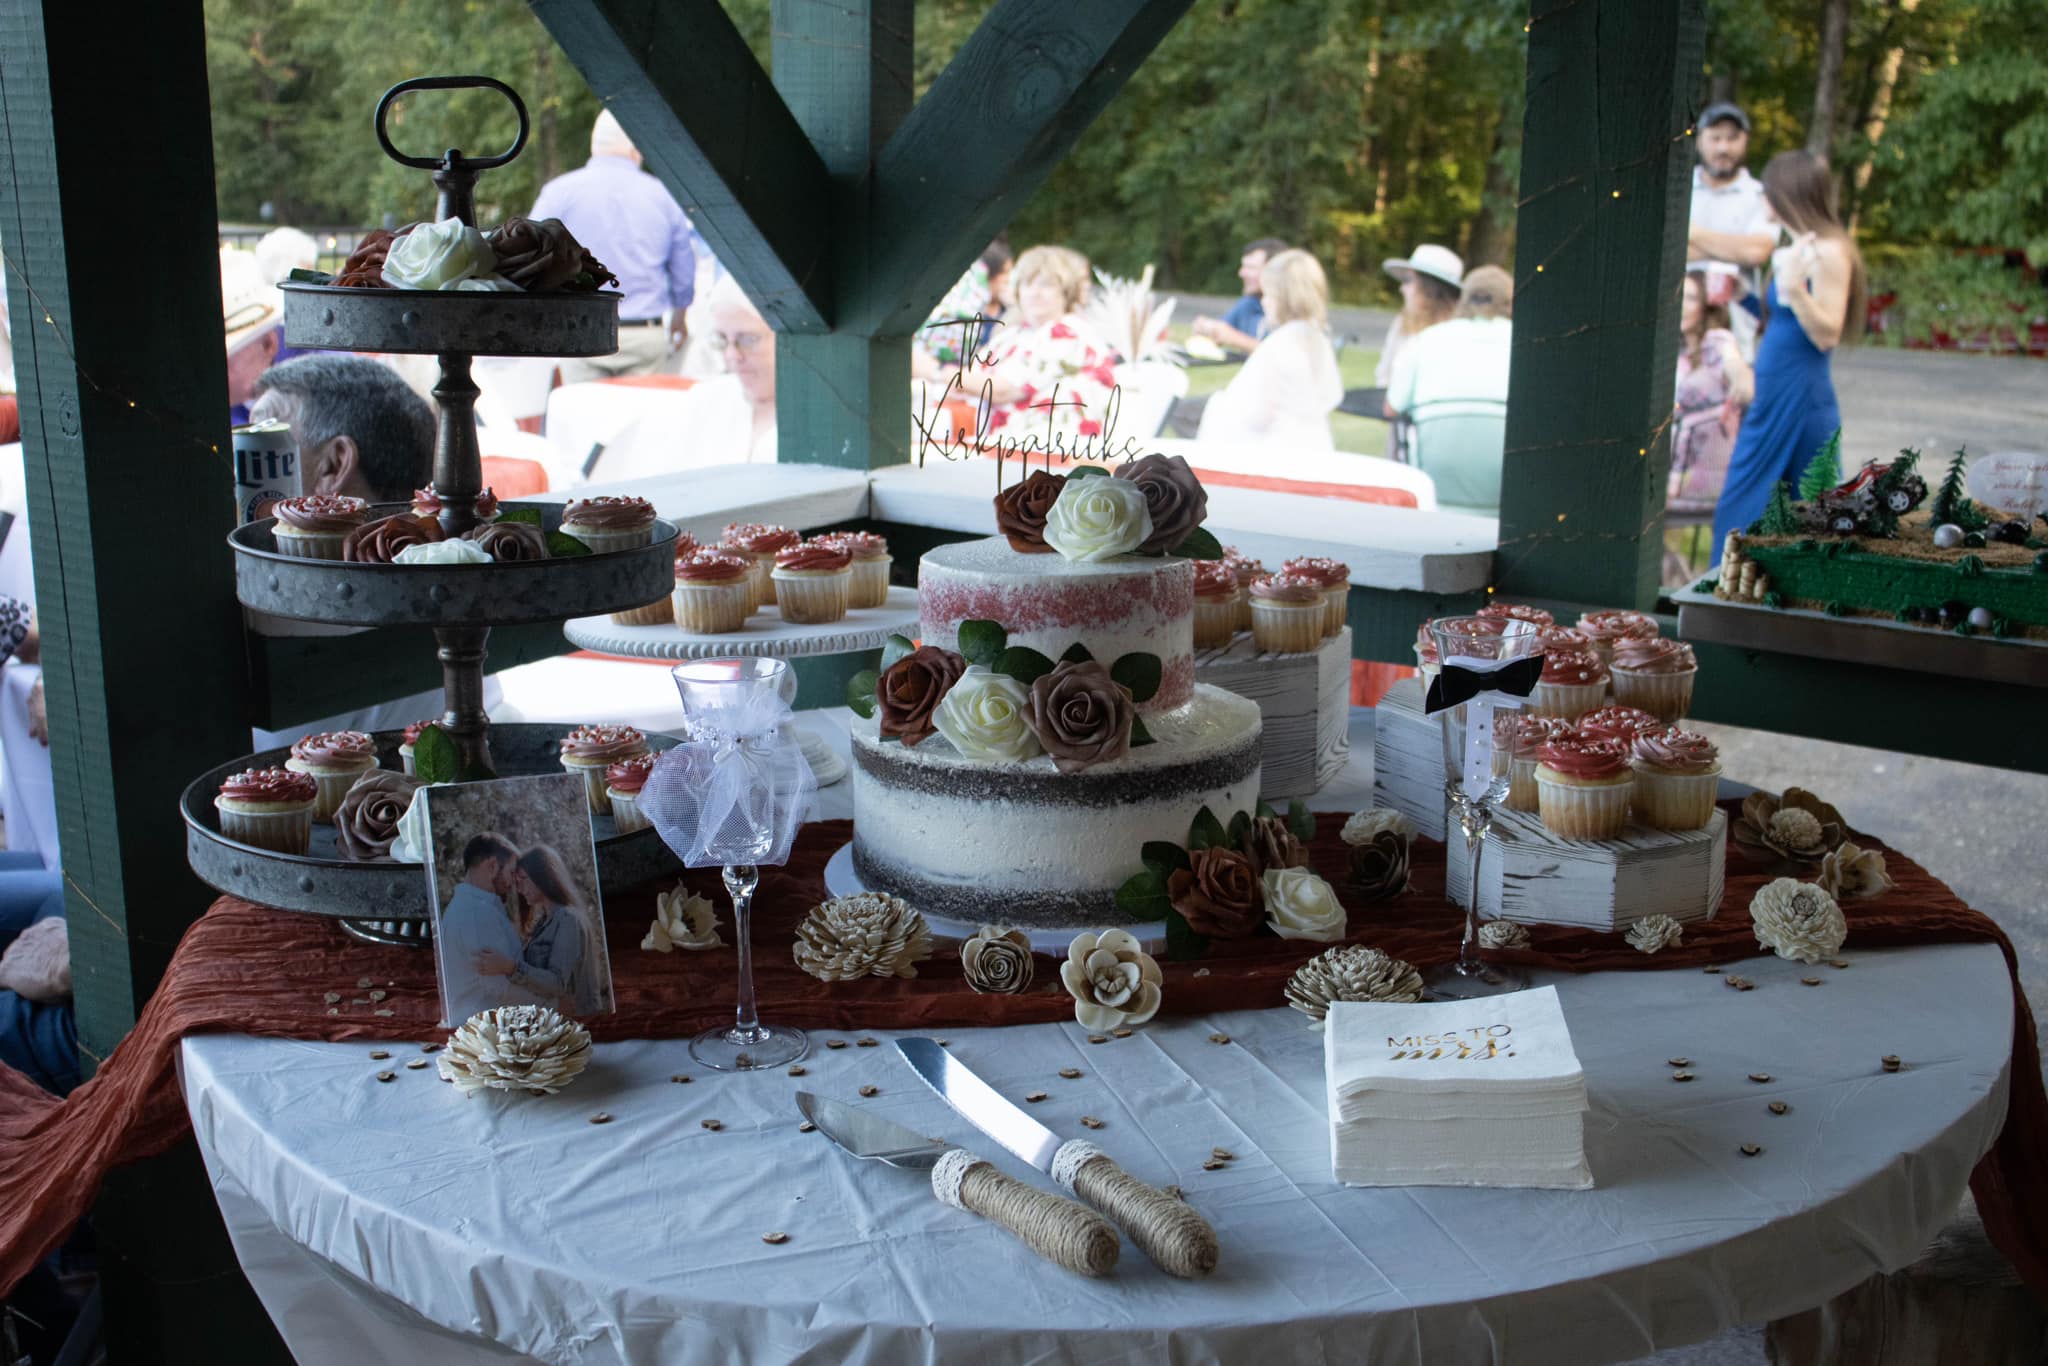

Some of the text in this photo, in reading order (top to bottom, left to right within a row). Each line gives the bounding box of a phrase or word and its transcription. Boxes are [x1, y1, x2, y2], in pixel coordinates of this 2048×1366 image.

[912, 372, 1144, 492] Kirkpatricks
[236, 449, 295, 488] Lite
[1387, 1024, 1512, 1047] MISS TO
